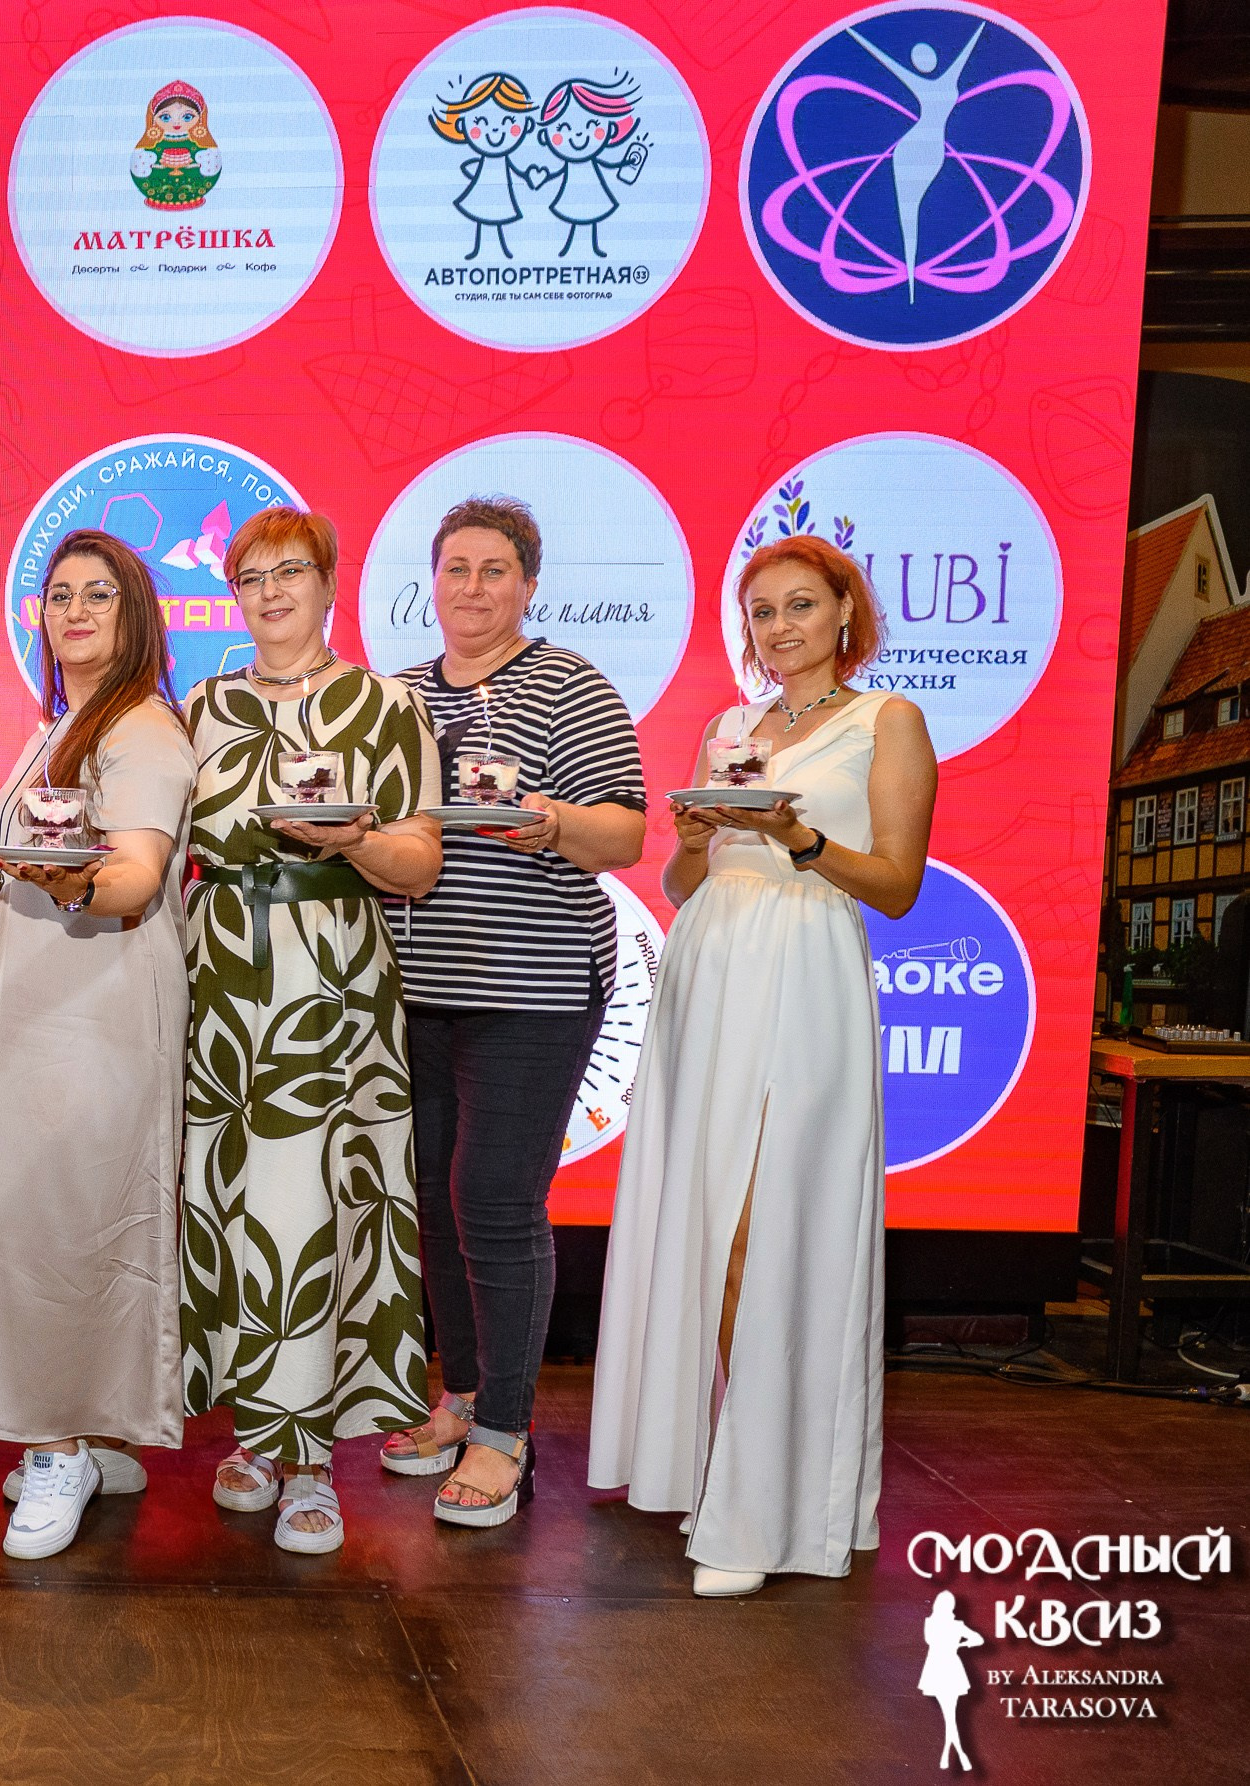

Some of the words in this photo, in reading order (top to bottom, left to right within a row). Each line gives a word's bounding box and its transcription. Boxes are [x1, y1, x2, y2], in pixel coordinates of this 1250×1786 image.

[73, 225, 276, 251] МАТРЁШКА
[71, 264, 120, 275] Десерты
[158, 263, 207, 274] Подарки
[245, 262, 277, 273] Кофе
[424, 265, 632, 286] АВТОПОРТРЕТНАЯ
[454, 292, 490, 301] СТУДИЯ,
[491, 292, 507, 301] ГДЕ
[509, 292, 521, 300] ТЫ
[523, 292, 541, 300] САМ
[543, 291, 564, 300] СЕБЕ
[566, 291, 613, 300] ФОТОГРАФ
[20, 483, 96, 588] ПРИХОДИ,
[98, 447, 233, 484] СРАЖАЙСЯ,
[558, 600, 655, 624] платья
[877, 649, 1028, 664] етическая
[867, 674, 957, 692] кухня
